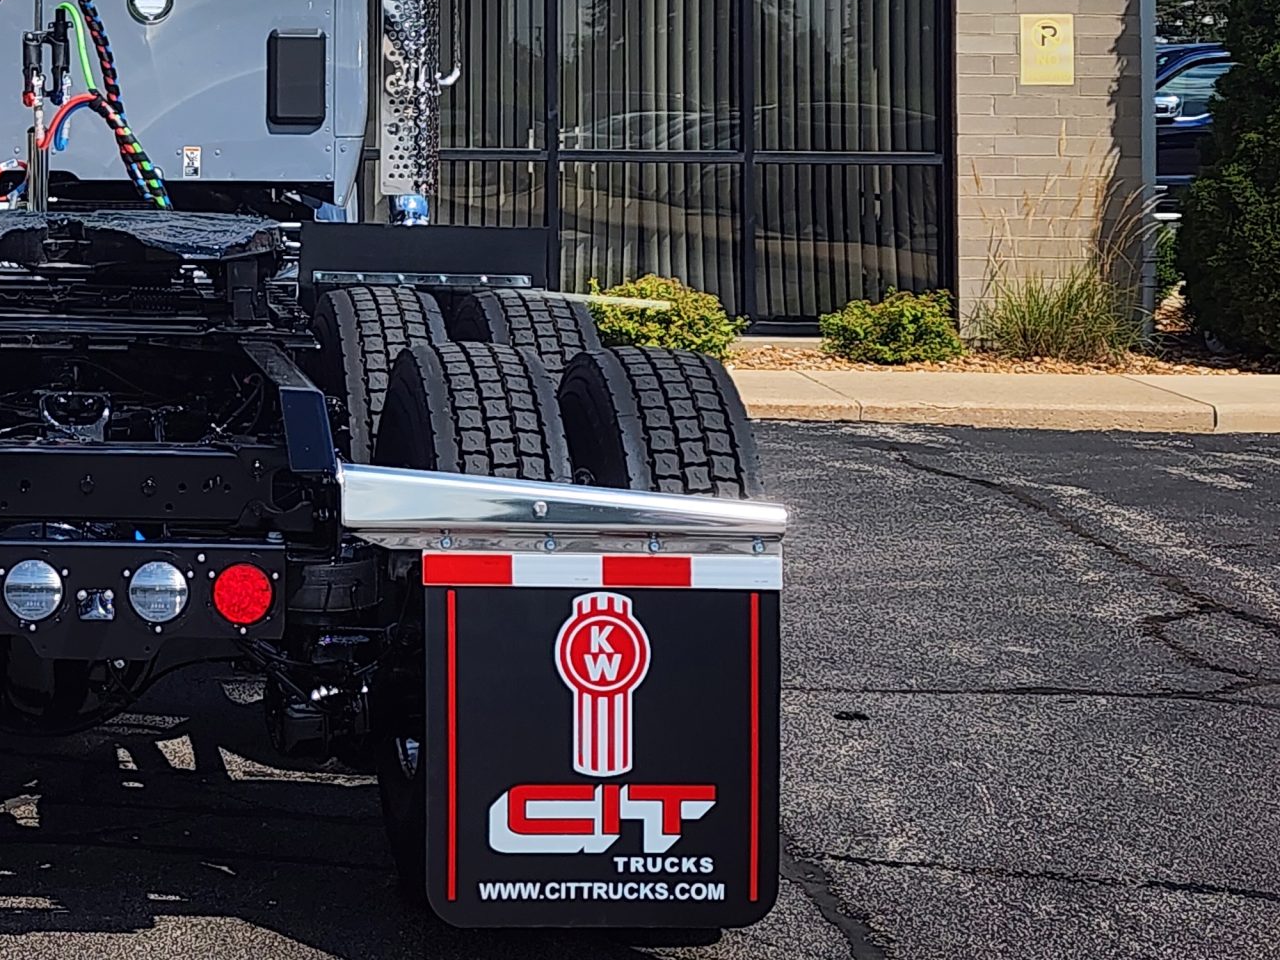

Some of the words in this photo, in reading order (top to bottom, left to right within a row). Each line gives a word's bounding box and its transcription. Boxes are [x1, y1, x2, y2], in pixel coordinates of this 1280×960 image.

[489, 784, 716, 853] CIT
[613, 856, 714, 873] TRUCKS
[479, 882, 725, 901] WWW.CITTRUCKS.COM
